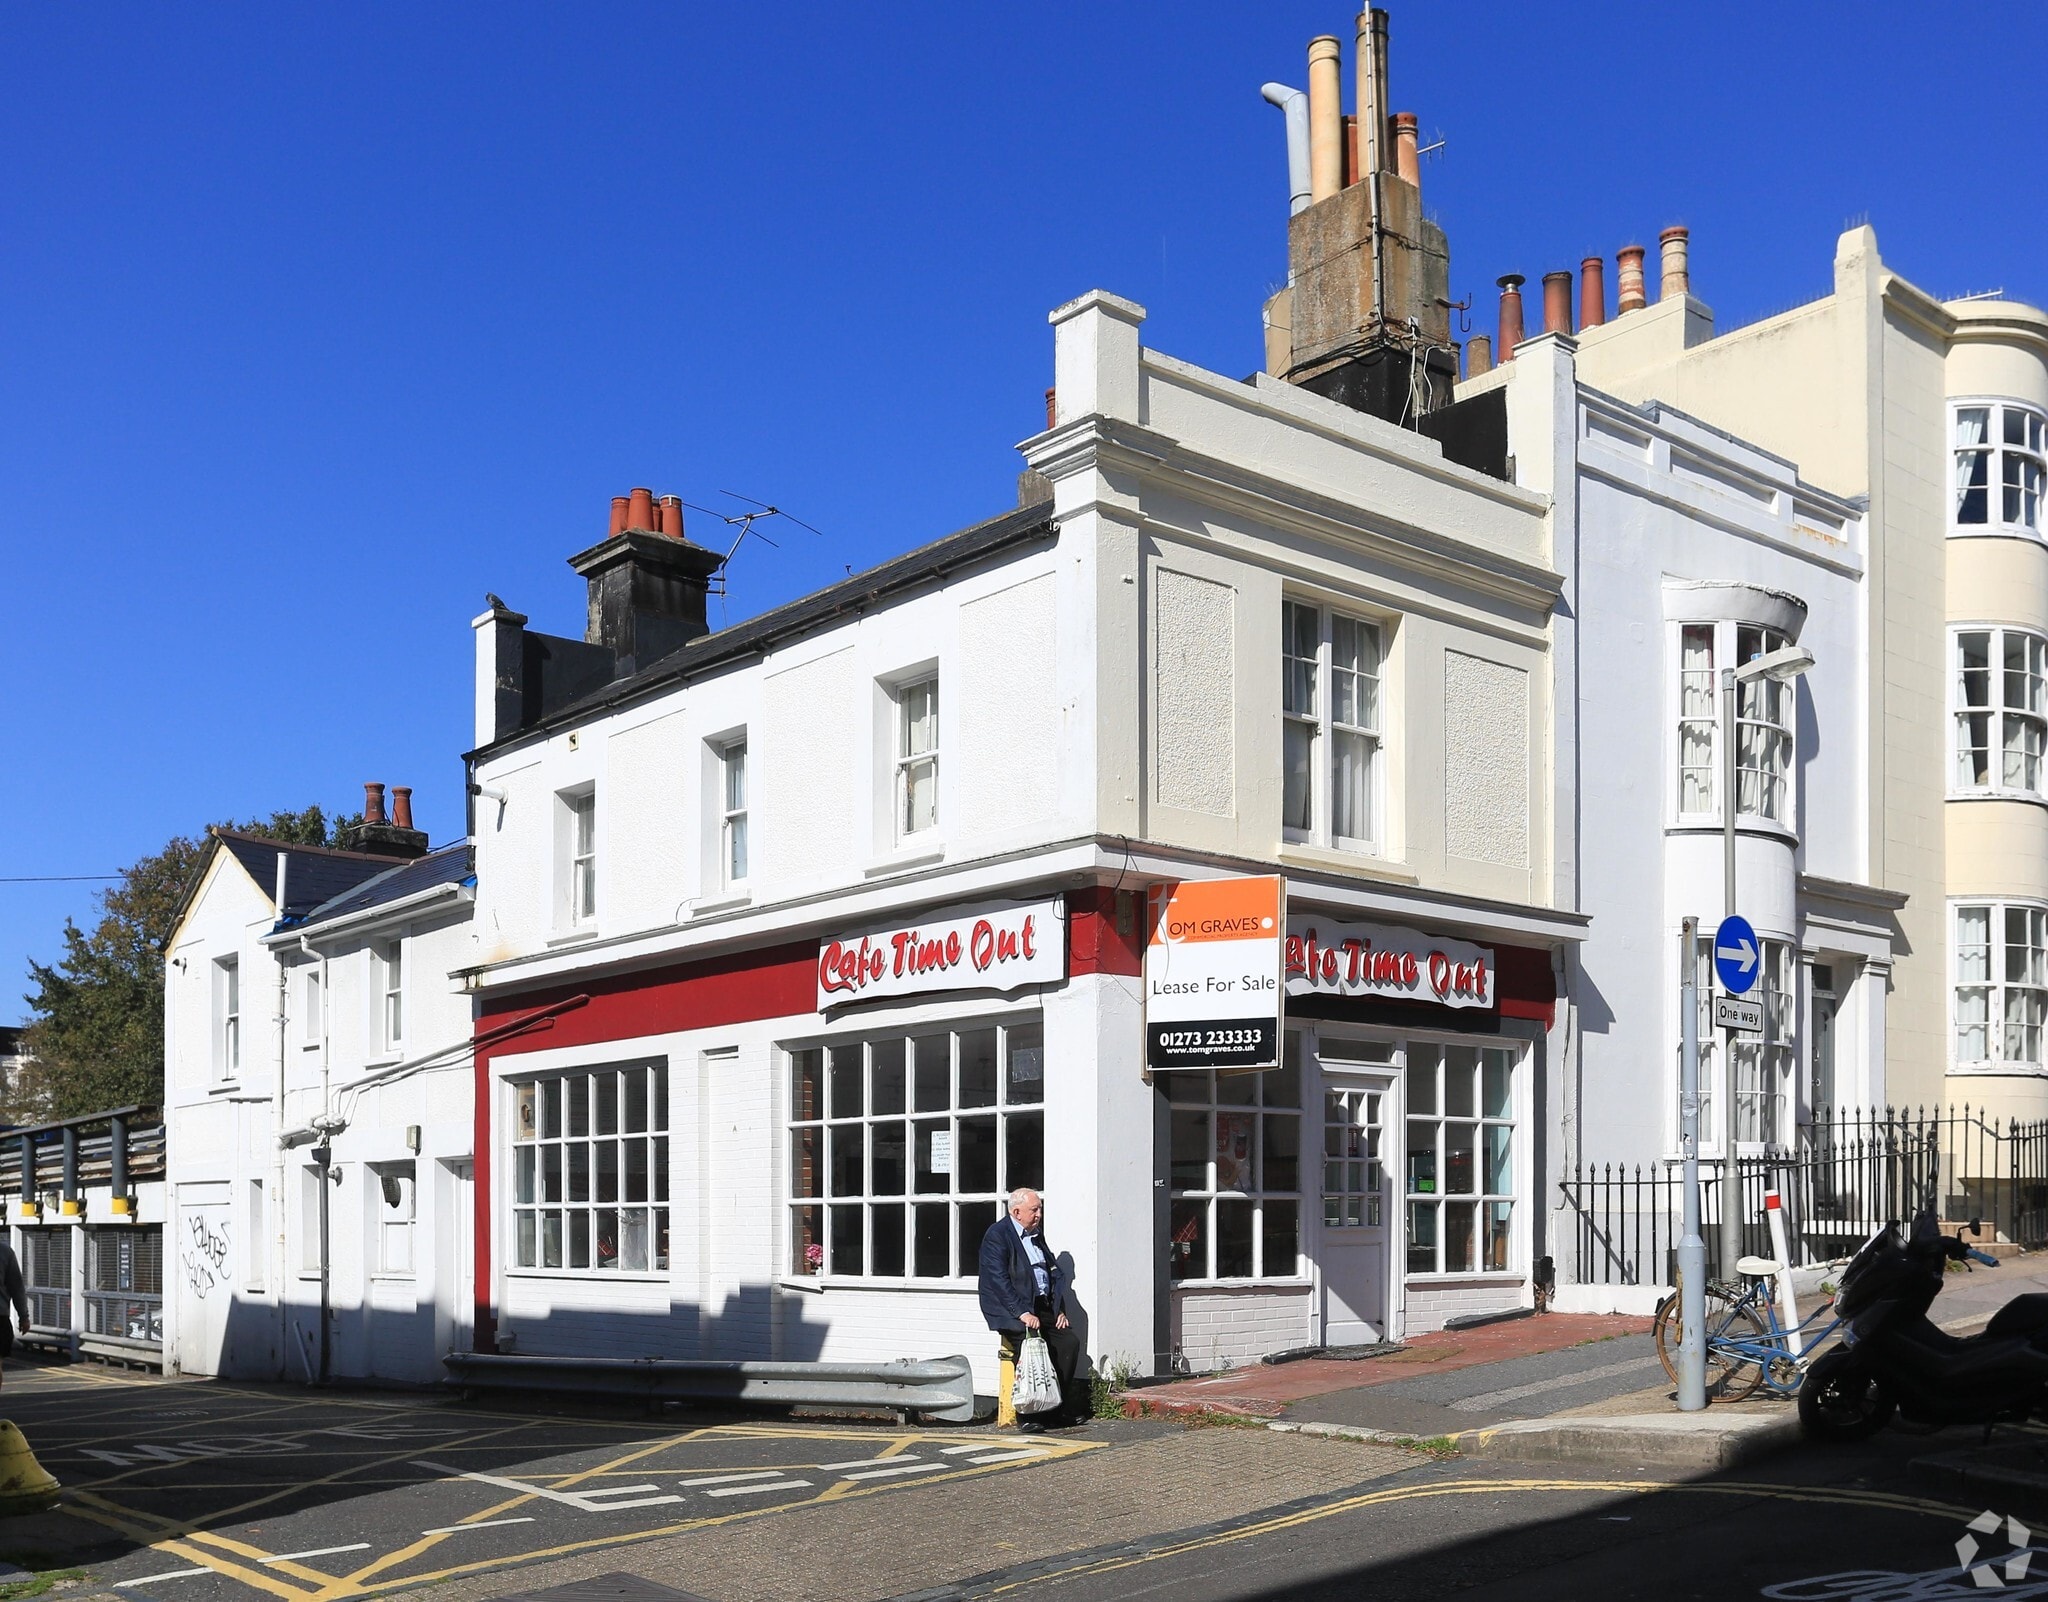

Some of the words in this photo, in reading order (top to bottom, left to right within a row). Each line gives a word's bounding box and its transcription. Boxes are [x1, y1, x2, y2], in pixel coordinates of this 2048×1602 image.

[1200, 917, 1259, 934] GRAVES
[819, 935, 886, 993] Cafe
[890, 928, 964, 977] Time
[970, 914, 1037, 972] Out
[1285, 928, 1339, 981] afe
[1341, 937, 1418, 985] Time
[1426, 950, 1487, 996] Out
[1153, 980, 1199, 995] Lease
[1207, 977, 1235, 992] For
[1242, 974, 1275, 990] Sale
[1720, 1005, 1738, 1020] One
[1741, 1012, 1759, 1026] way
[1160, 1031, 1202, 1047] 01273
[1206, 1029, 1262, 1045] 233333
[1166, 1043, 1256, 1055] www.tomgraves.co.uk
